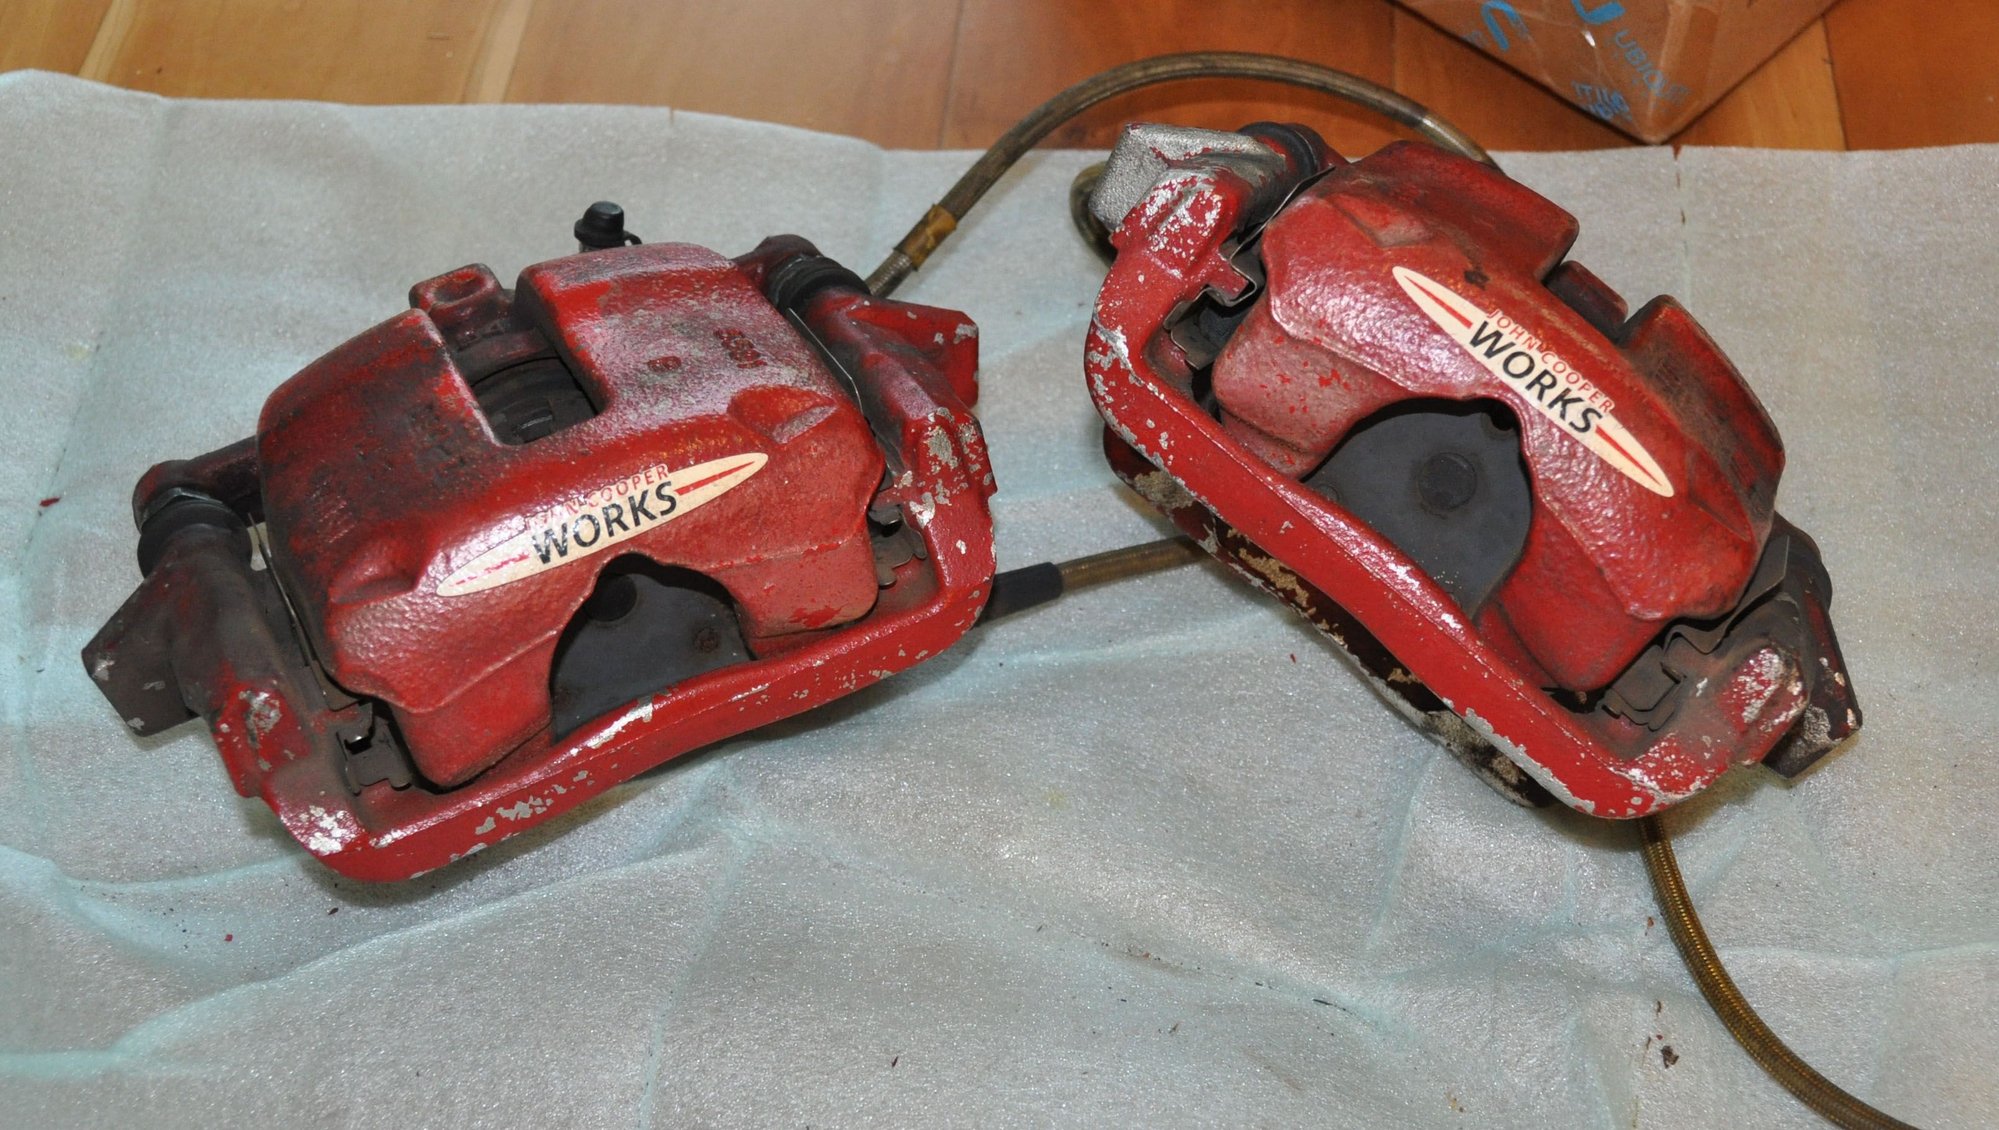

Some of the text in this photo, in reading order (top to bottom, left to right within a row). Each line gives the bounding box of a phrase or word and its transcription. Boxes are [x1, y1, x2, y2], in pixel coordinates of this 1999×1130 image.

[1469, 321, 1603, 433] WORKS
[1487, 309, 1615, 413] JOHN COOPER
[530, 481, 677, 565] WORKS
[587, 465, 668, 508] COOPER
